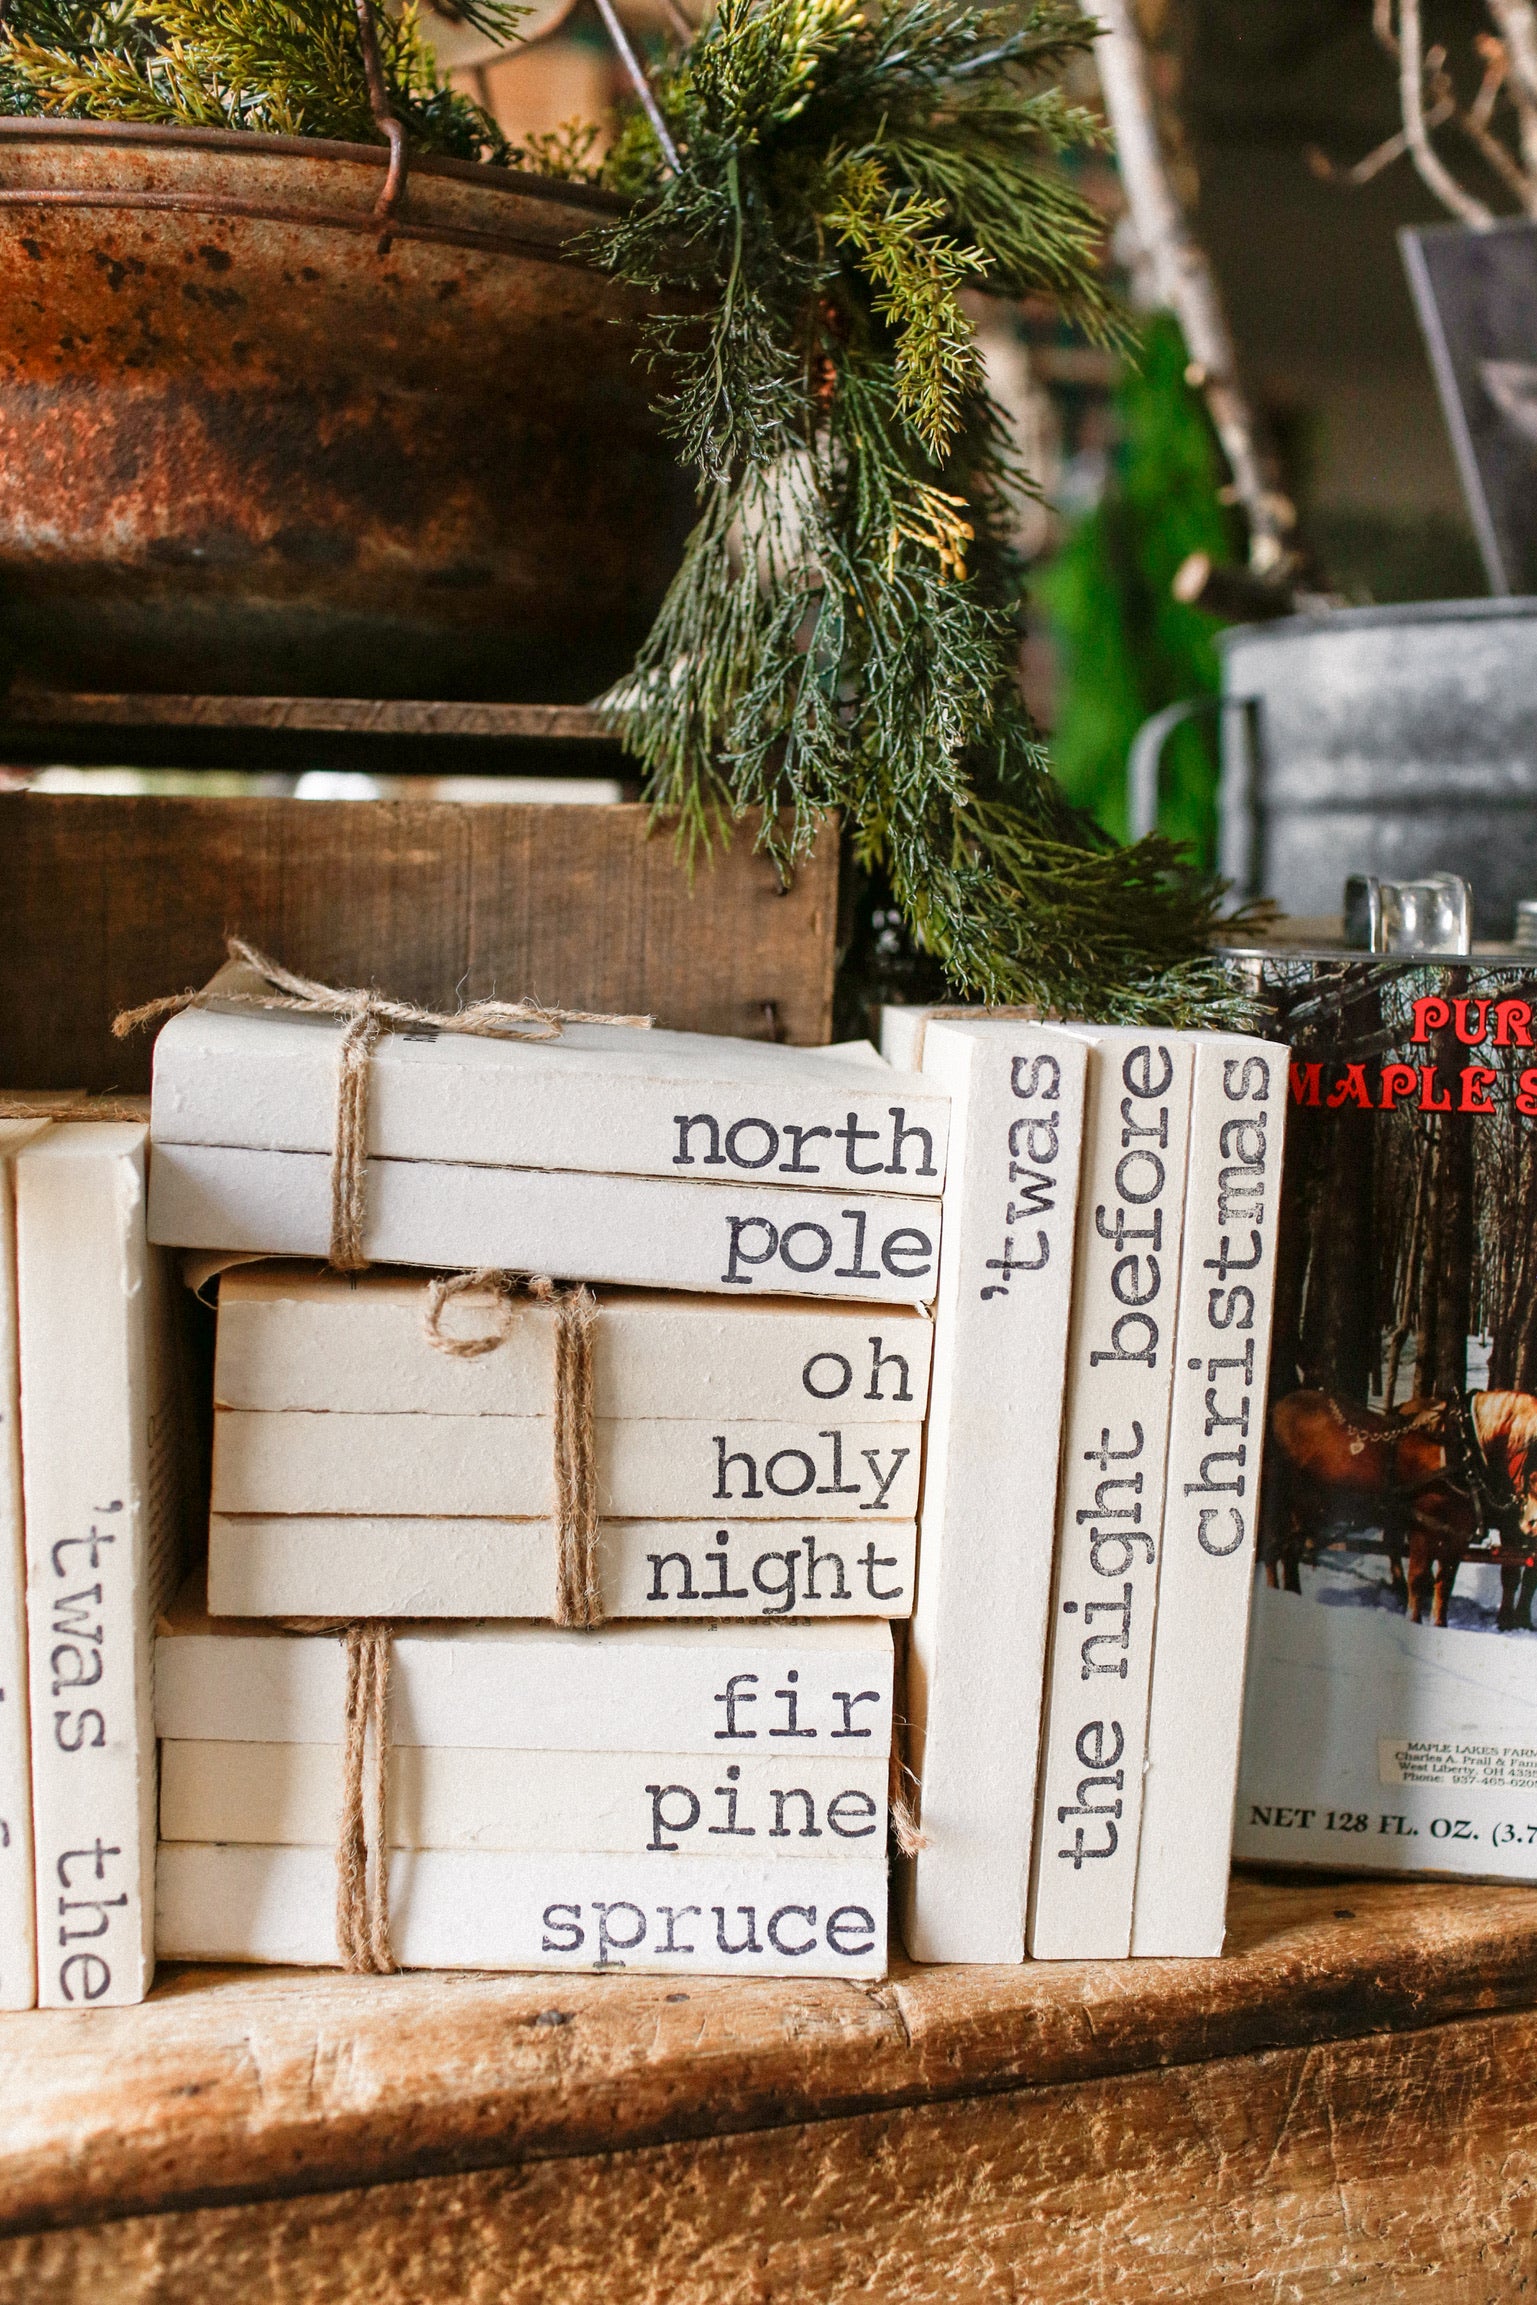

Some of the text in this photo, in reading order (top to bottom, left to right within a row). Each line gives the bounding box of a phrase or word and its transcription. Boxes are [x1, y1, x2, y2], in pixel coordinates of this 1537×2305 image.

[1410, 996, 1537, 1047] PUR
[1289, 1062, 1497, 1113] MAPLE
[673, 1107, 937, 1176] north
[980, 1054, 1061, 1301] 'twas
[721, 1210, 932, 1284] pole
[1184, 1056, 1270, 1557] christmas
[802, 1336, 913, 1401] oh
[712, 1430, 910, 1510] holy
[1058, 1045, 1174, 1870] the night before
[646, 1529, 904, 1615] night
[714, 1669, 880, 1739] fir
[50, 1500, 127, 2001] 'twas the
[1395, 1751, 1443, 1763] Charles
[1495, 1758, 1505, 1767] &
[1399, 1761, 1428, 1772] West
[1483, 1767, 1504, 1777] OH
[1403, 1771, 1444, 1784] Phone:
[1407, 1742, 1452, 1753] MAPLE
[1455, 1745, 1499, 1757] LAKES
[645, 1765, 877, 1851] pine
[1250, 1804, 1316, 1829] NET
[1324, 1811, 1370, 1833] 128
[1377, 1815, 1419, 1836] FL.
[1430, 1818, 1479, 1840] OZ.
[542, 1901, 876, 1969] spruce
